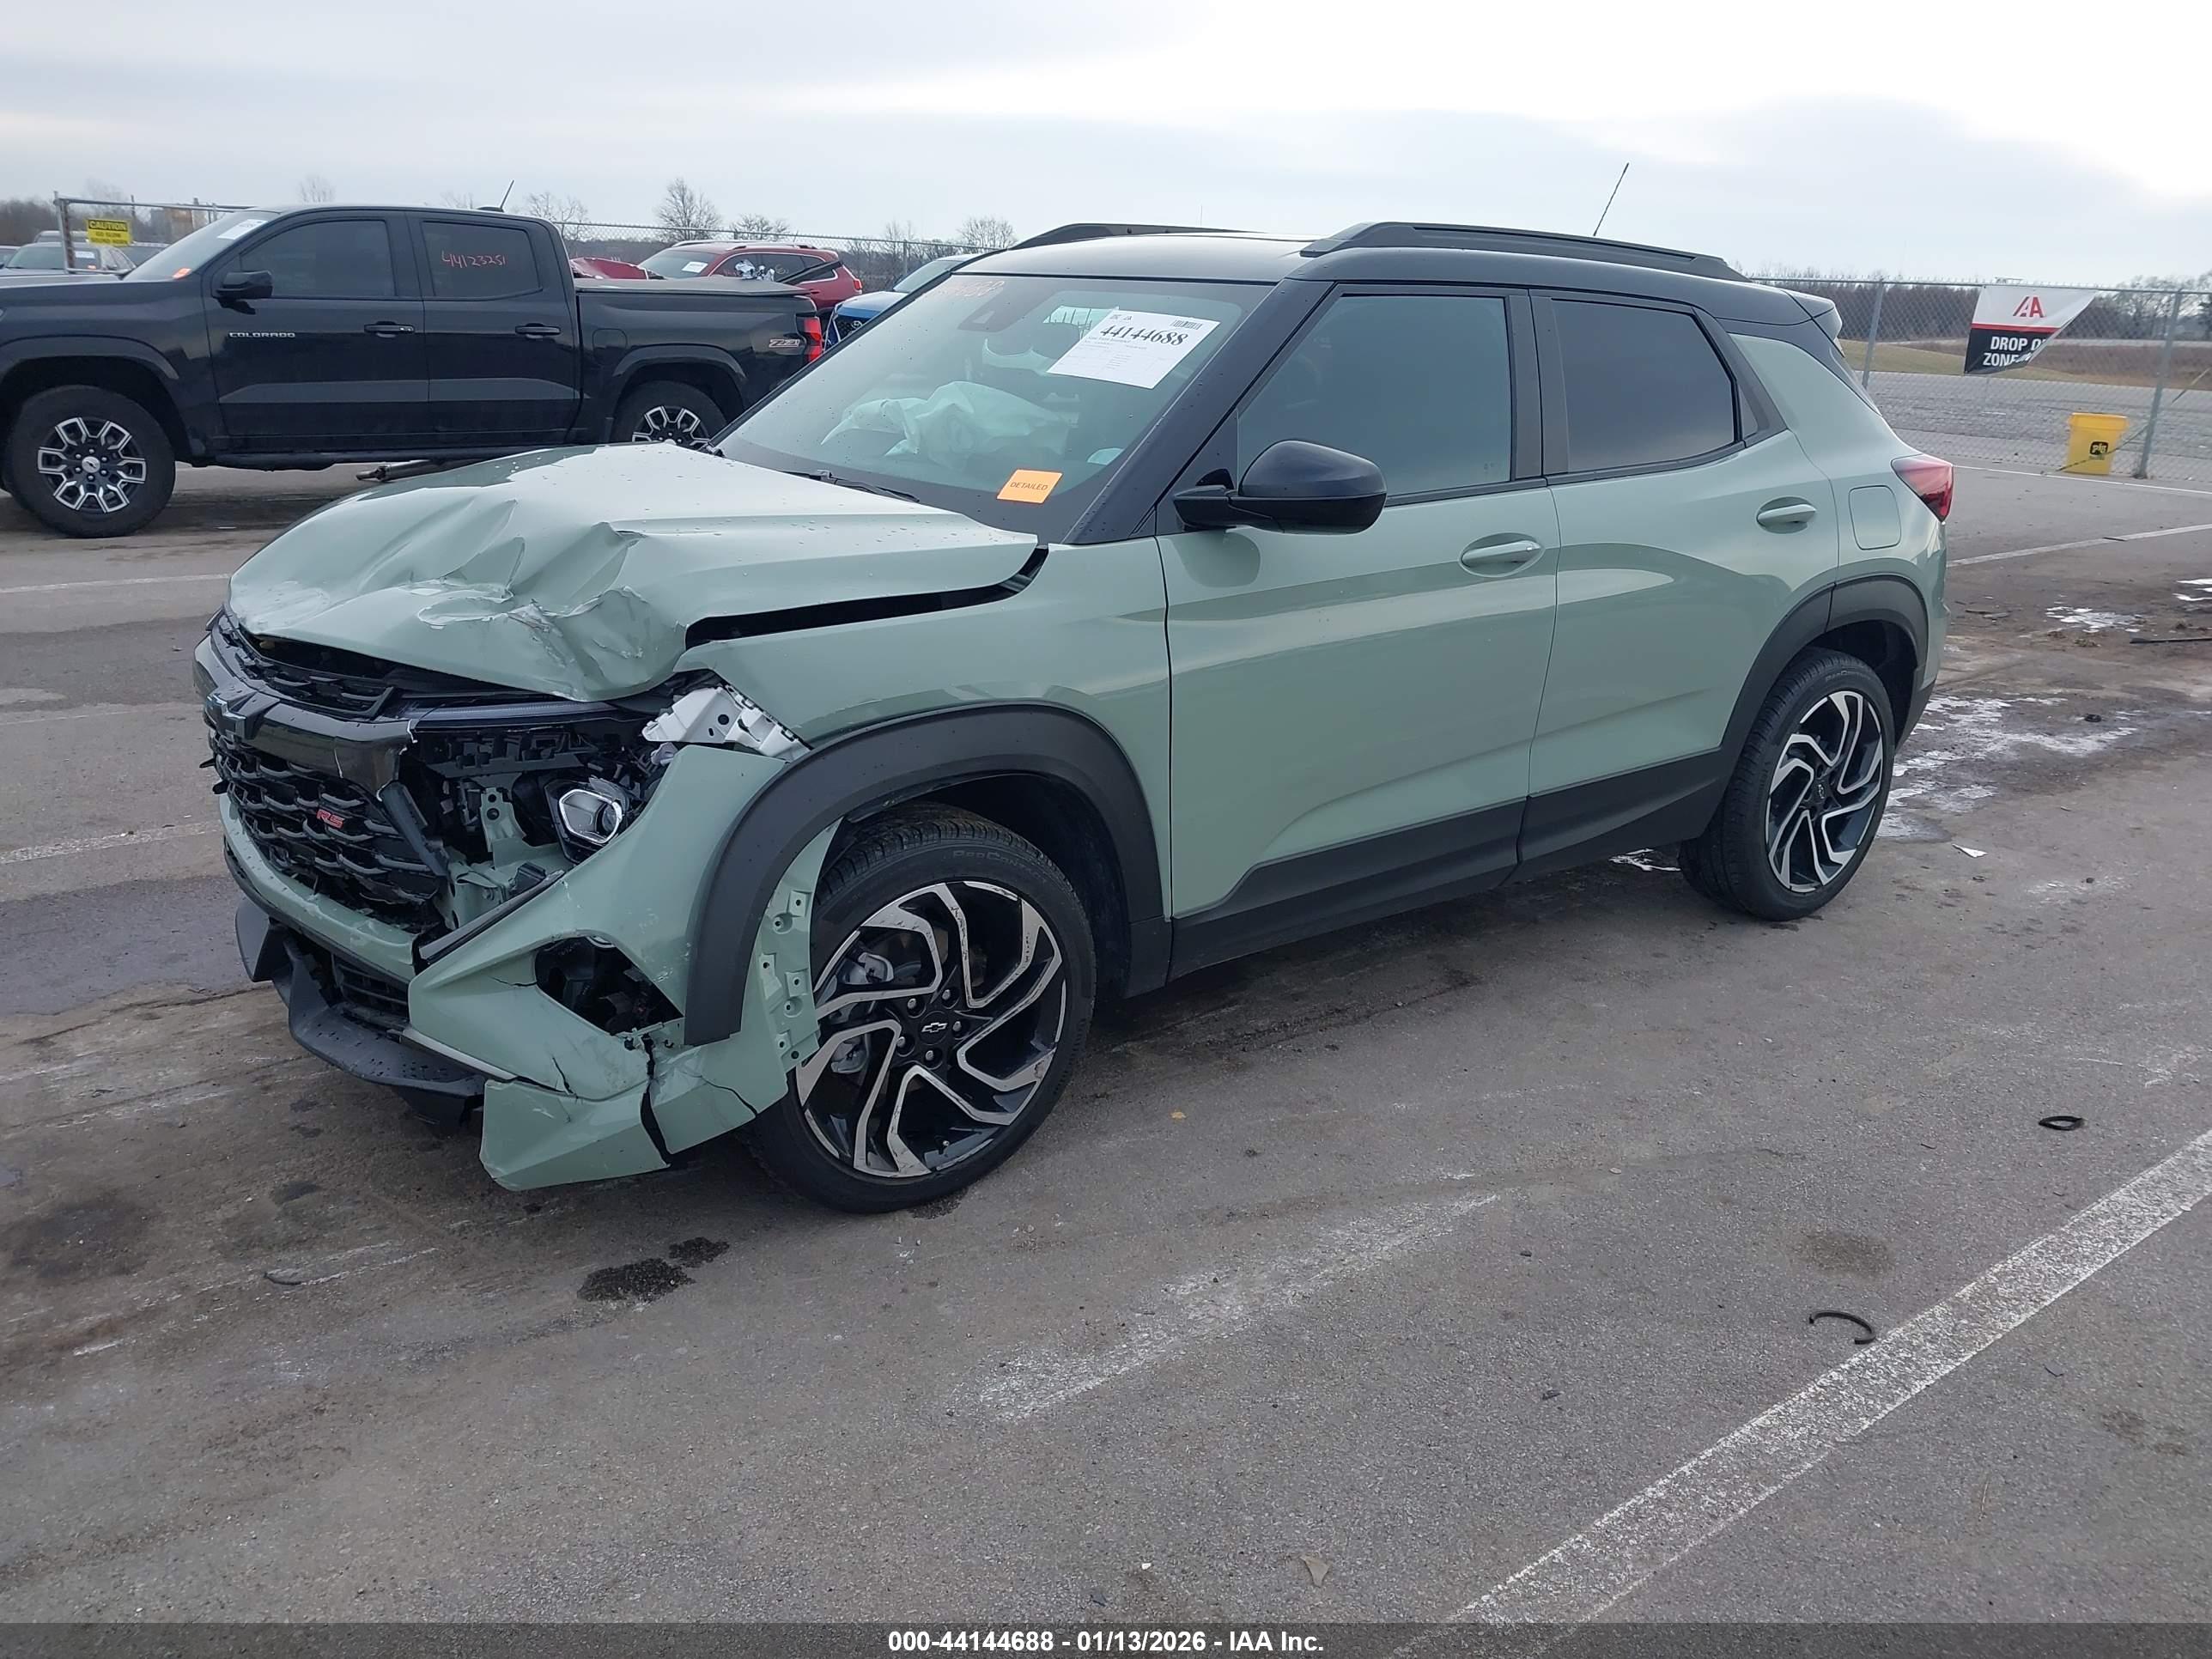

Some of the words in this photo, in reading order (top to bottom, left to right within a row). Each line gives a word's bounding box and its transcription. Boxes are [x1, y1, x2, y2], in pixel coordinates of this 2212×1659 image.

[89, 221, 127, 230] CAUTION
[1100, 325, 1188, 346] 44144688
[1990, 336, 2028, 351] DROP
[1010, 482, 1048, 491] DETAILED
[317, 809, 345, 829] RS
